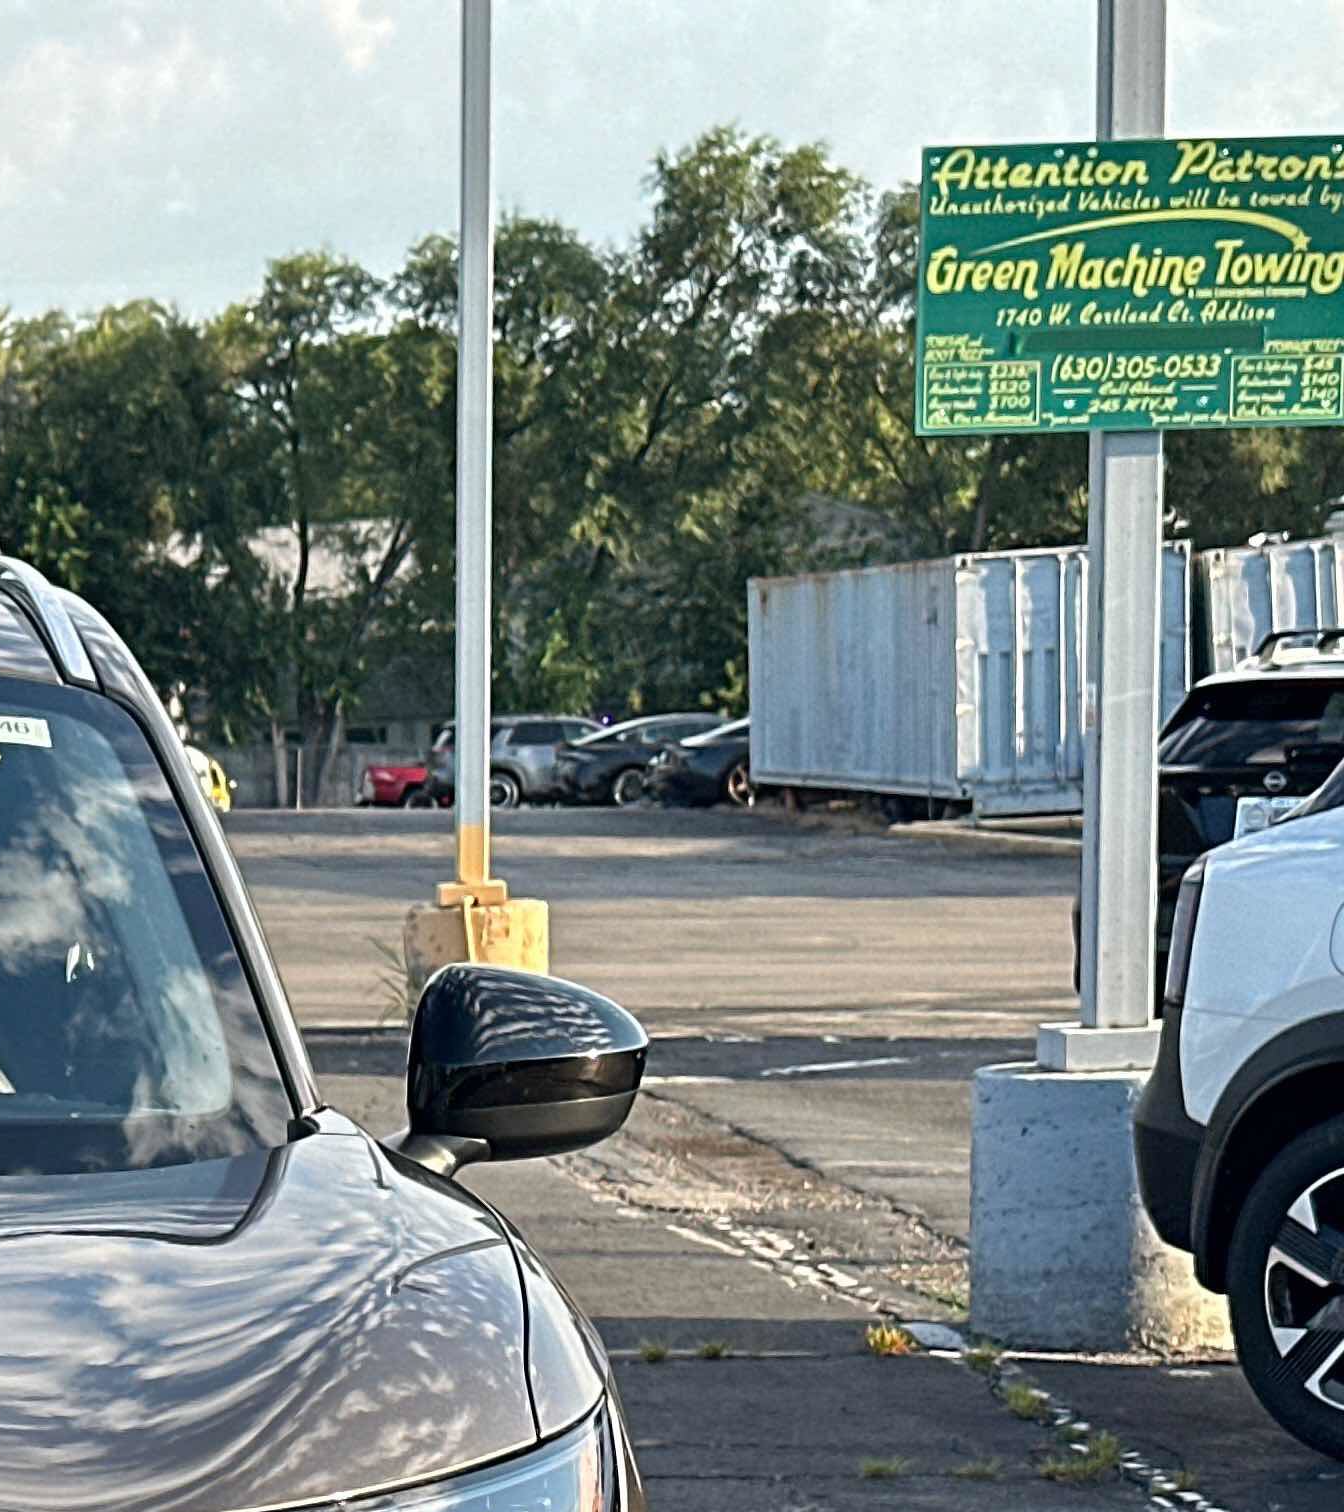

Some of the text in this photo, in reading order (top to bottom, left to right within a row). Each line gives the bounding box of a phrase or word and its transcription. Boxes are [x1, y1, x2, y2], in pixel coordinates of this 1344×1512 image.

[931, 147, 1150, 197] Attention
[929, 184, 1342, 220] Unauthorized Vehicles will be towed by
[926, 239, 1344, 300] Green Machine Towing
[996, 308, 1042, 327] 1740
[1048, 302, 1071, 326] W.
[1079, 301, 1163, 326] Cortland
[1200, 300, 1275, 325] Addison
